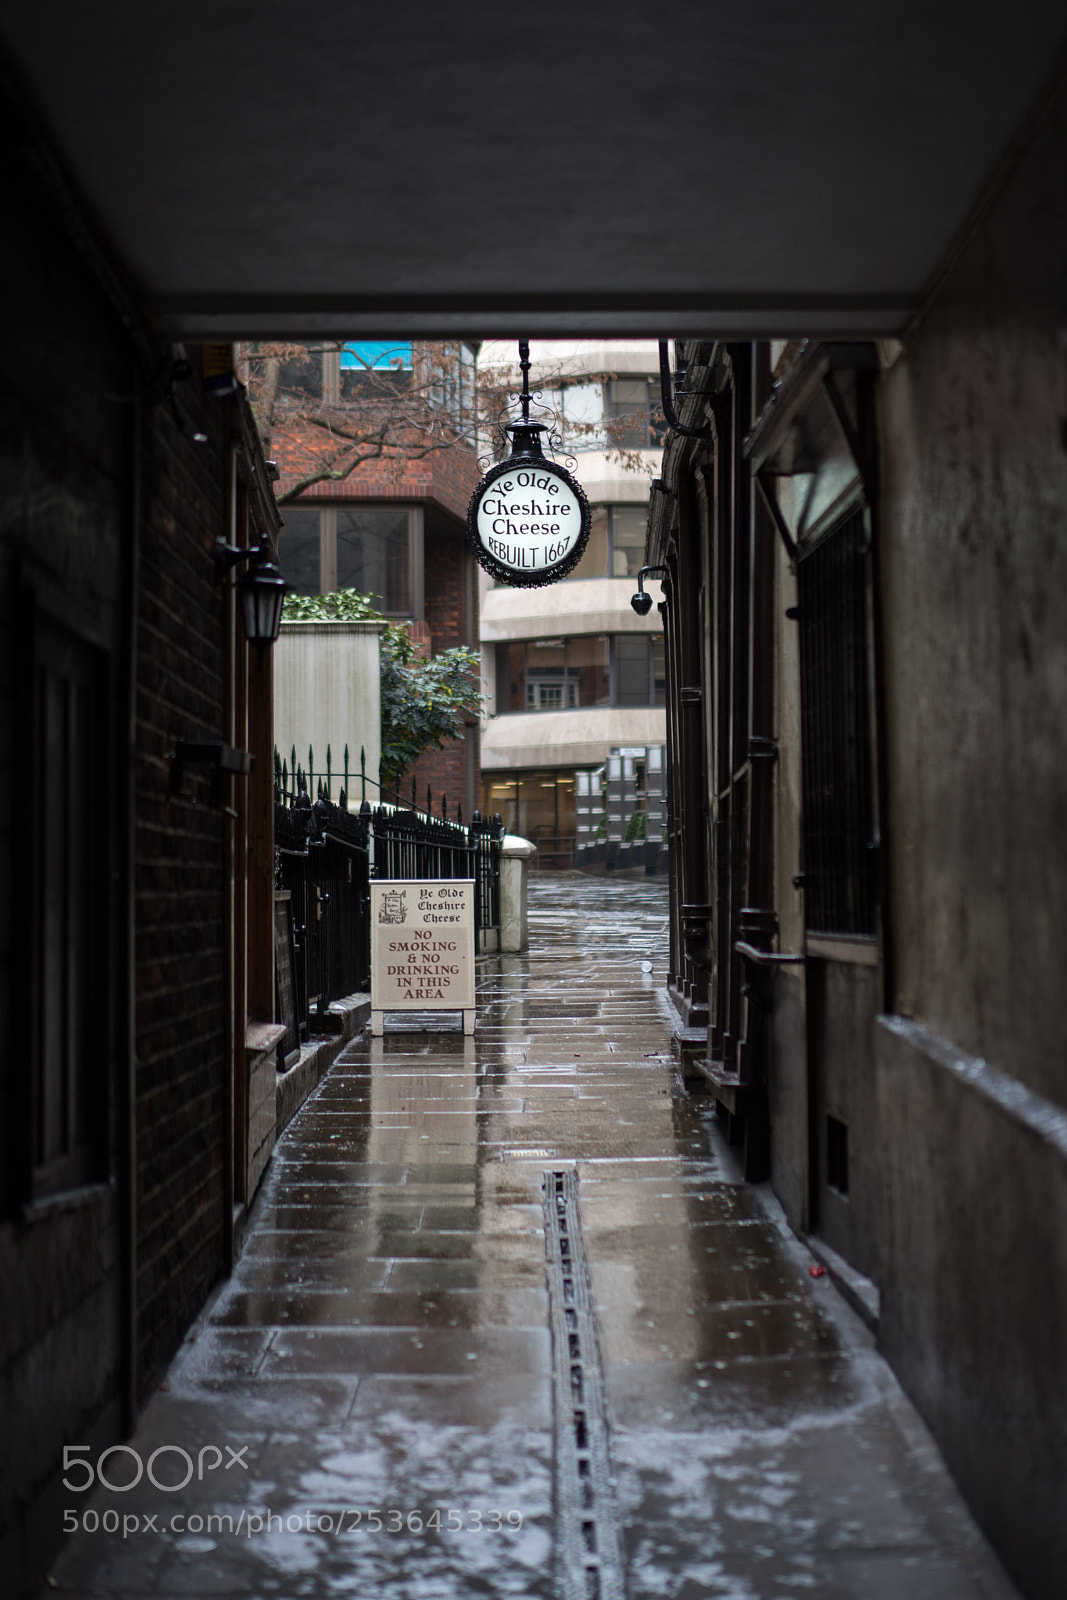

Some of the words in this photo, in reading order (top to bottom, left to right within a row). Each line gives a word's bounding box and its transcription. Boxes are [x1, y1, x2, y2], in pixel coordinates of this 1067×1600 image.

[491, 480, 514, 497] Ye
[517, 473, 559, 495] Olde
[482, 499, 571, 515] Cheshire
[492, 519, 560, 534] Cheese
[489, 536, 539, 567] REBUILT
[545, 536, 570, 564] 1667
[419, 889, 433, 899] Ye
[438, 889, 464, 898] Olde
[418, 902, 466, 911] Cheshire
[423, 914, 461, 923] Cheese
[414, 931, 432, 940] NO
[389, 942, 456, 951] SMOKING
[408, 954, 416, 963] &
[422, 954, 440, 963] NO
[387, 965, 459, 975] DRINKING
[397, 978, 412, 987] IN
[417, 977, 451, 986] THIS
[404, 989, 445, 999] AREA
